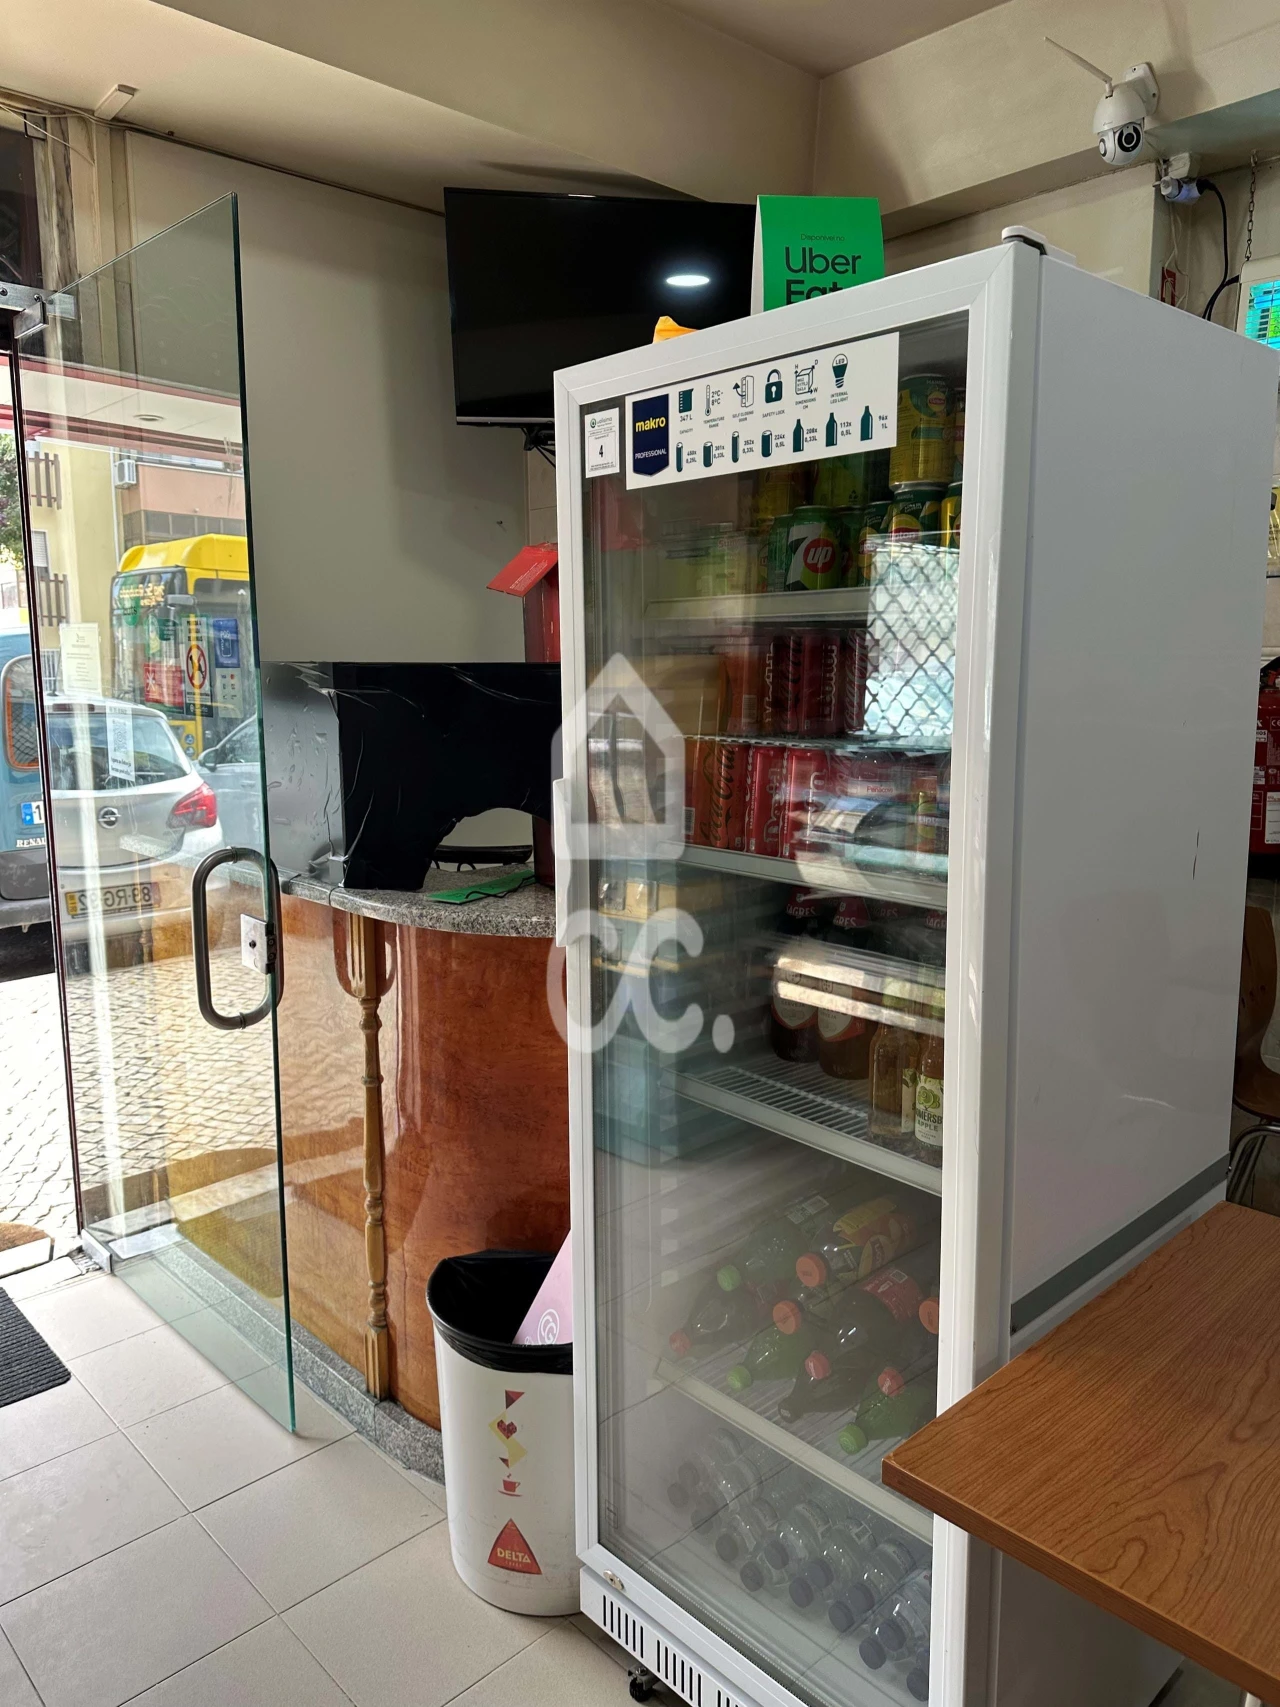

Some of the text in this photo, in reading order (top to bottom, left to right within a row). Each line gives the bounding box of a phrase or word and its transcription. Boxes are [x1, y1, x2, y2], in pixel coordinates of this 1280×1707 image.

[785, 246, 862, 275] Uber
[636, 416, 666, 432] makro
[599, 444, 604, 458] 4
[634, 448, 667, 460] PROFESSIONAL
[16, 837, 46, 848] RENA
[833, 915, 857, 927] GRES
[918, 1120, 938, 1132] APPLE
[497, 1548, 531, 1564] DELTA
